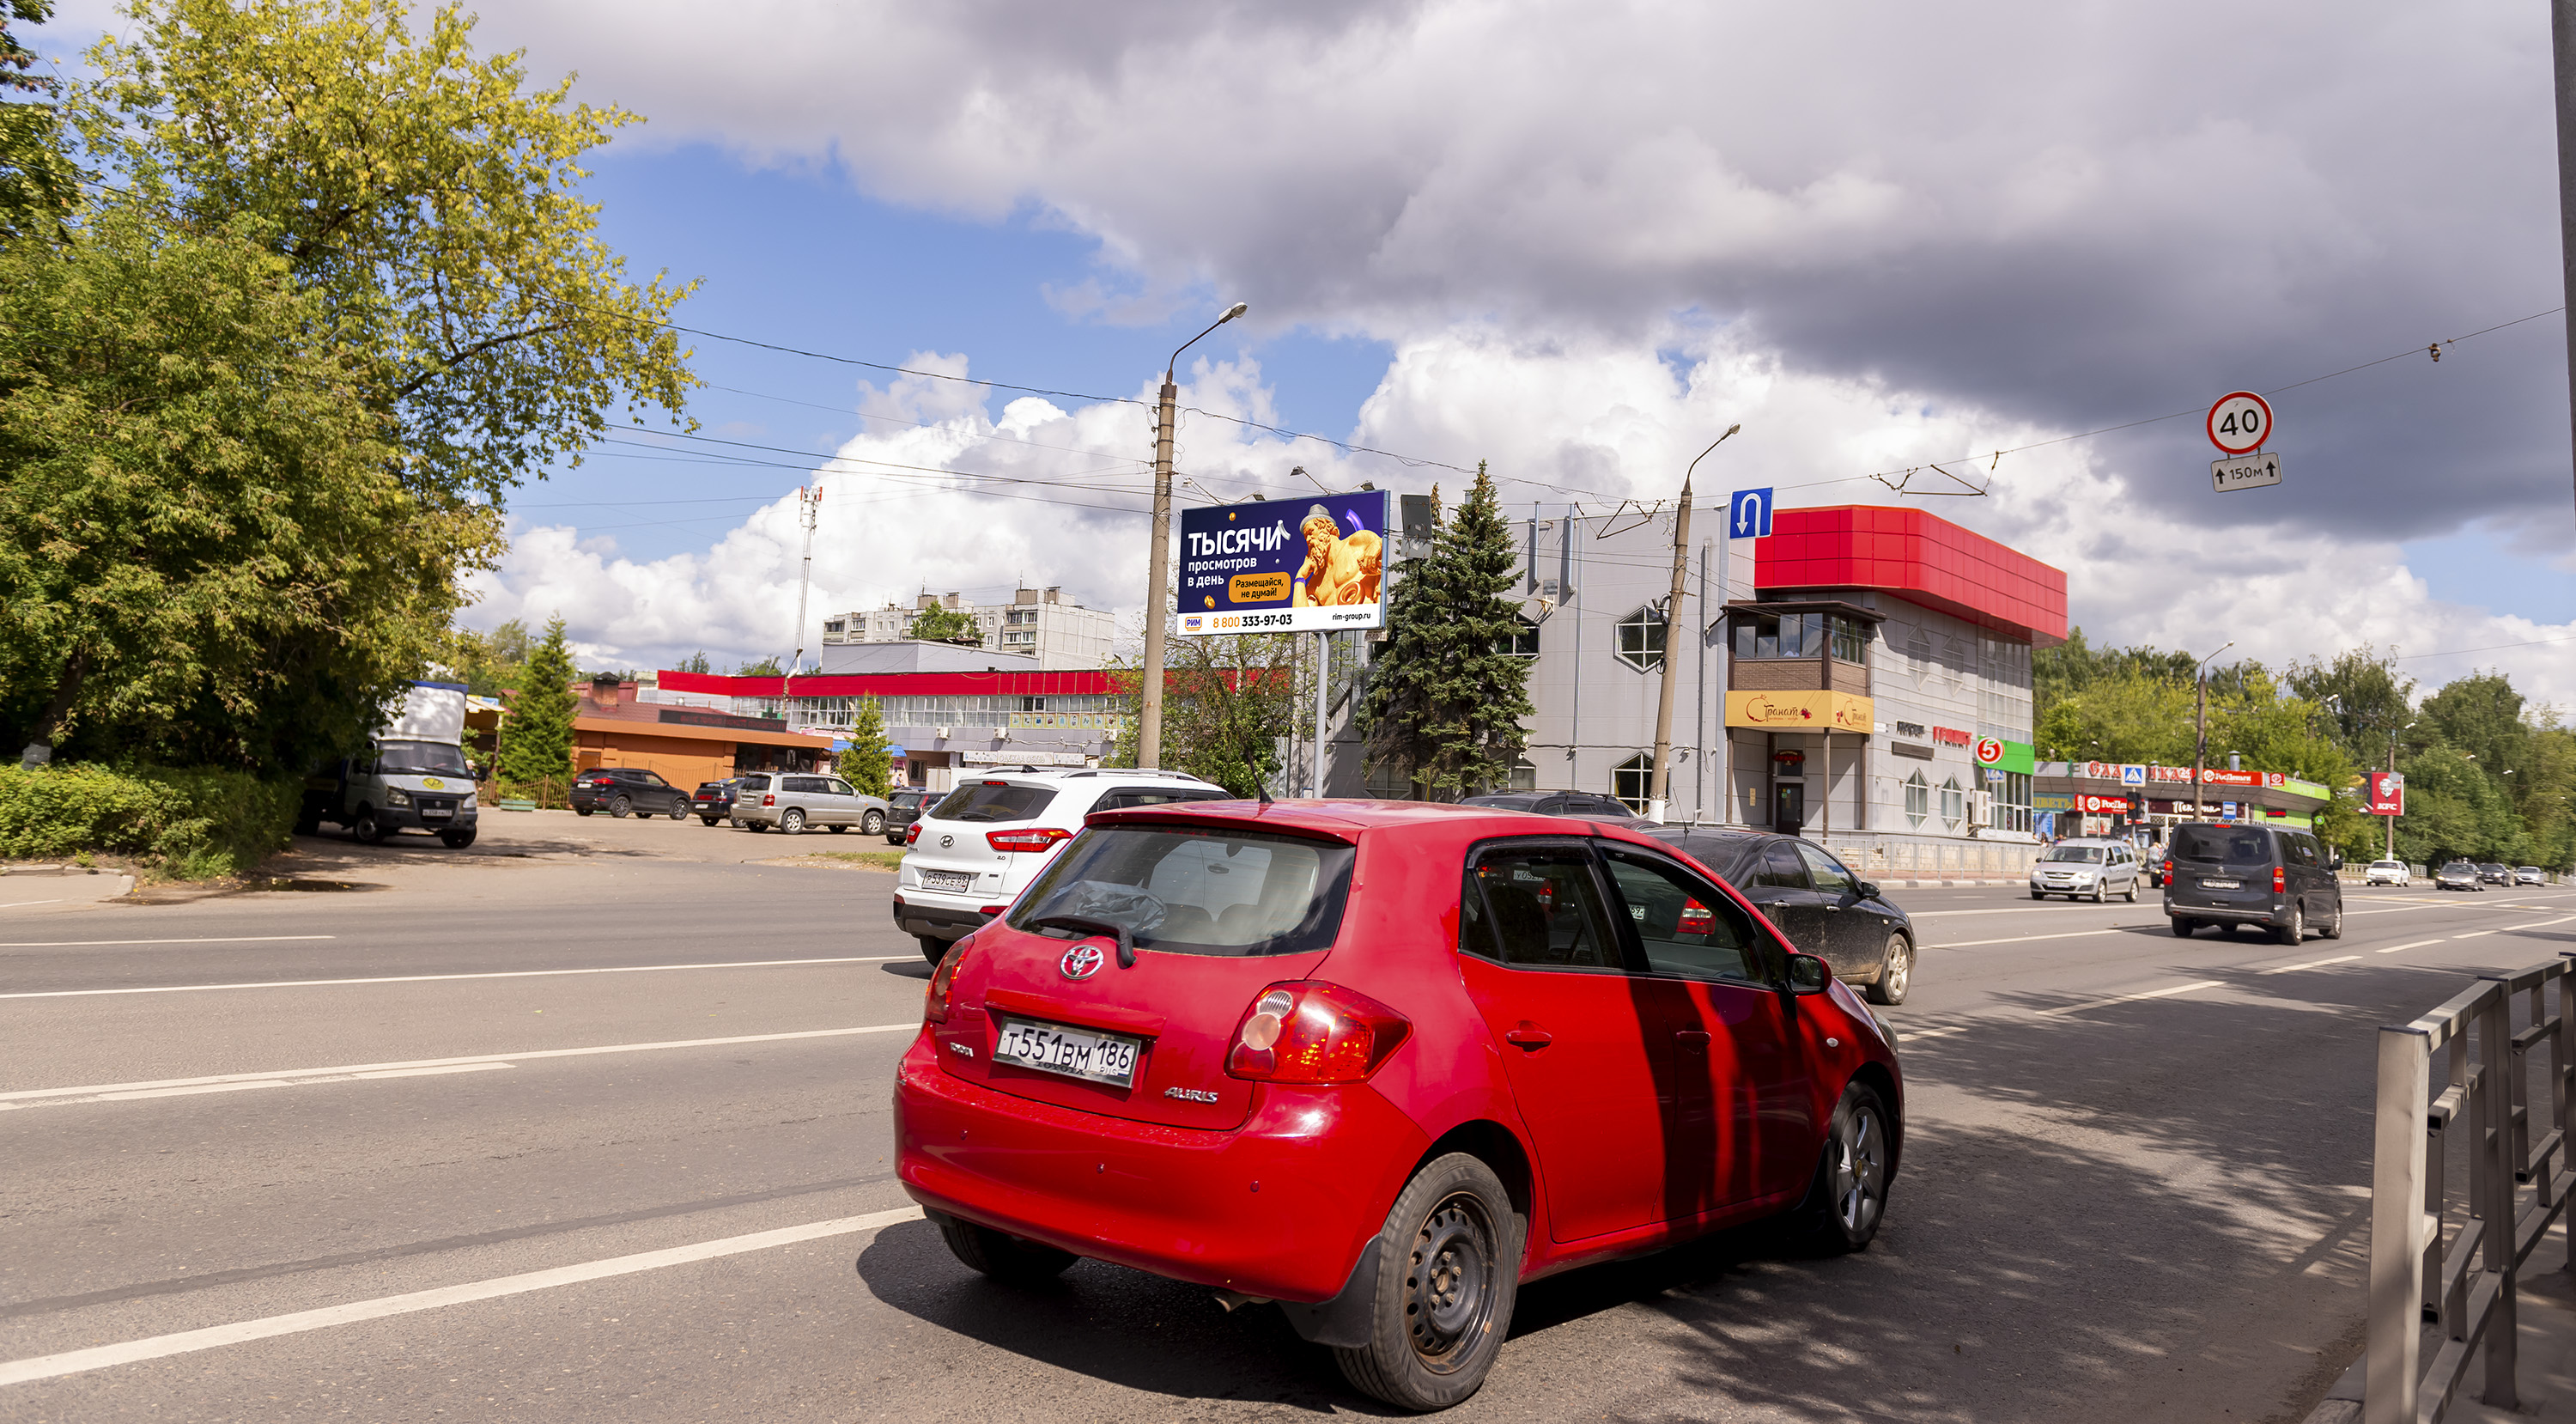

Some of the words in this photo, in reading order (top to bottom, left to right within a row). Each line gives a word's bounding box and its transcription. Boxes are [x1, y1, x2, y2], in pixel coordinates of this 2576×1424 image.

[2220, 409, 2259, 435] 40
[2229, 466, 2263, 480] 150м
[1188, 525, 1282, 557] ТЫСЯЧИ
[1188, 557, 1257, 575] просмотров
[1188, 577, 1194, 587] в
[1196, 575, 1224, 588] день
[1236, 577, 1284, 588] Размещайся,
[1251, 588, 1277, 599] думай!
[1187, 618, 1200, 627] РИМ
[1213, 618, 1219, 628] 8
[1221, 617, 1240, 628] 800
[1242, 613, 1292, 627] 333-97-03
[1332, 613, 1371, 622] rim-group.ru
[1982, 739, 1997, 759] 5
[927, 873, 956, 886] Р539СЕ
[957, 874, 967, 885] 69
[1008, 1028, 1092, 1070] Т551ВМ
[1097, 1040, 1131, 1069] 186
[1036, 1061, 1086, 1076] TOYOTA
[1100, 1066, 1117, 1076] RUS
[1164, 1086, 1218, 1103] AURIS
